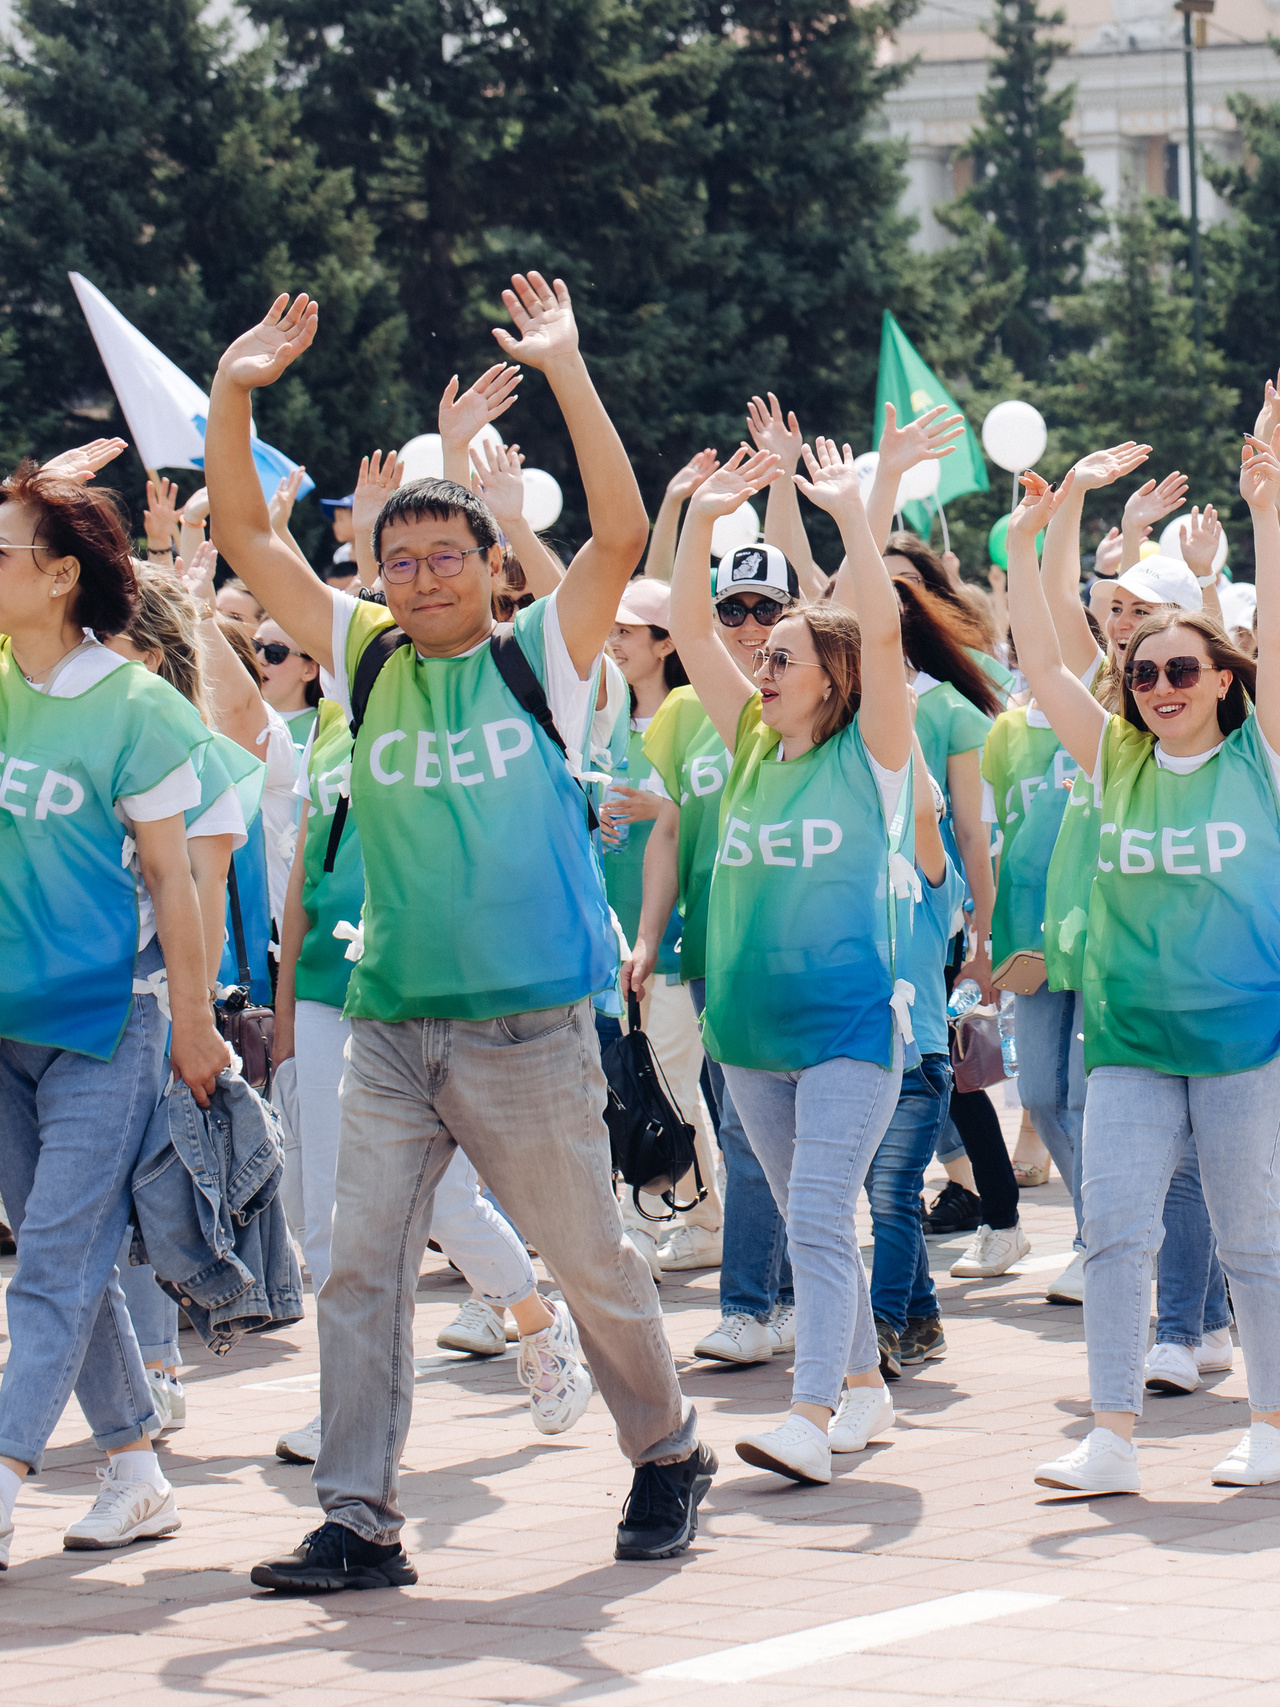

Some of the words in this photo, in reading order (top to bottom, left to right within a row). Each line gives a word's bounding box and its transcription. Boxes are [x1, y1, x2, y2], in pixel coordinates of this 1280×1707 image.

[369, 717, 534, 787] СБЕР
[0, 751, 84, 820] ЕР
[716, 812, 843, 868] БЕР
[1098, 821, 1247, 875] СБЕР
